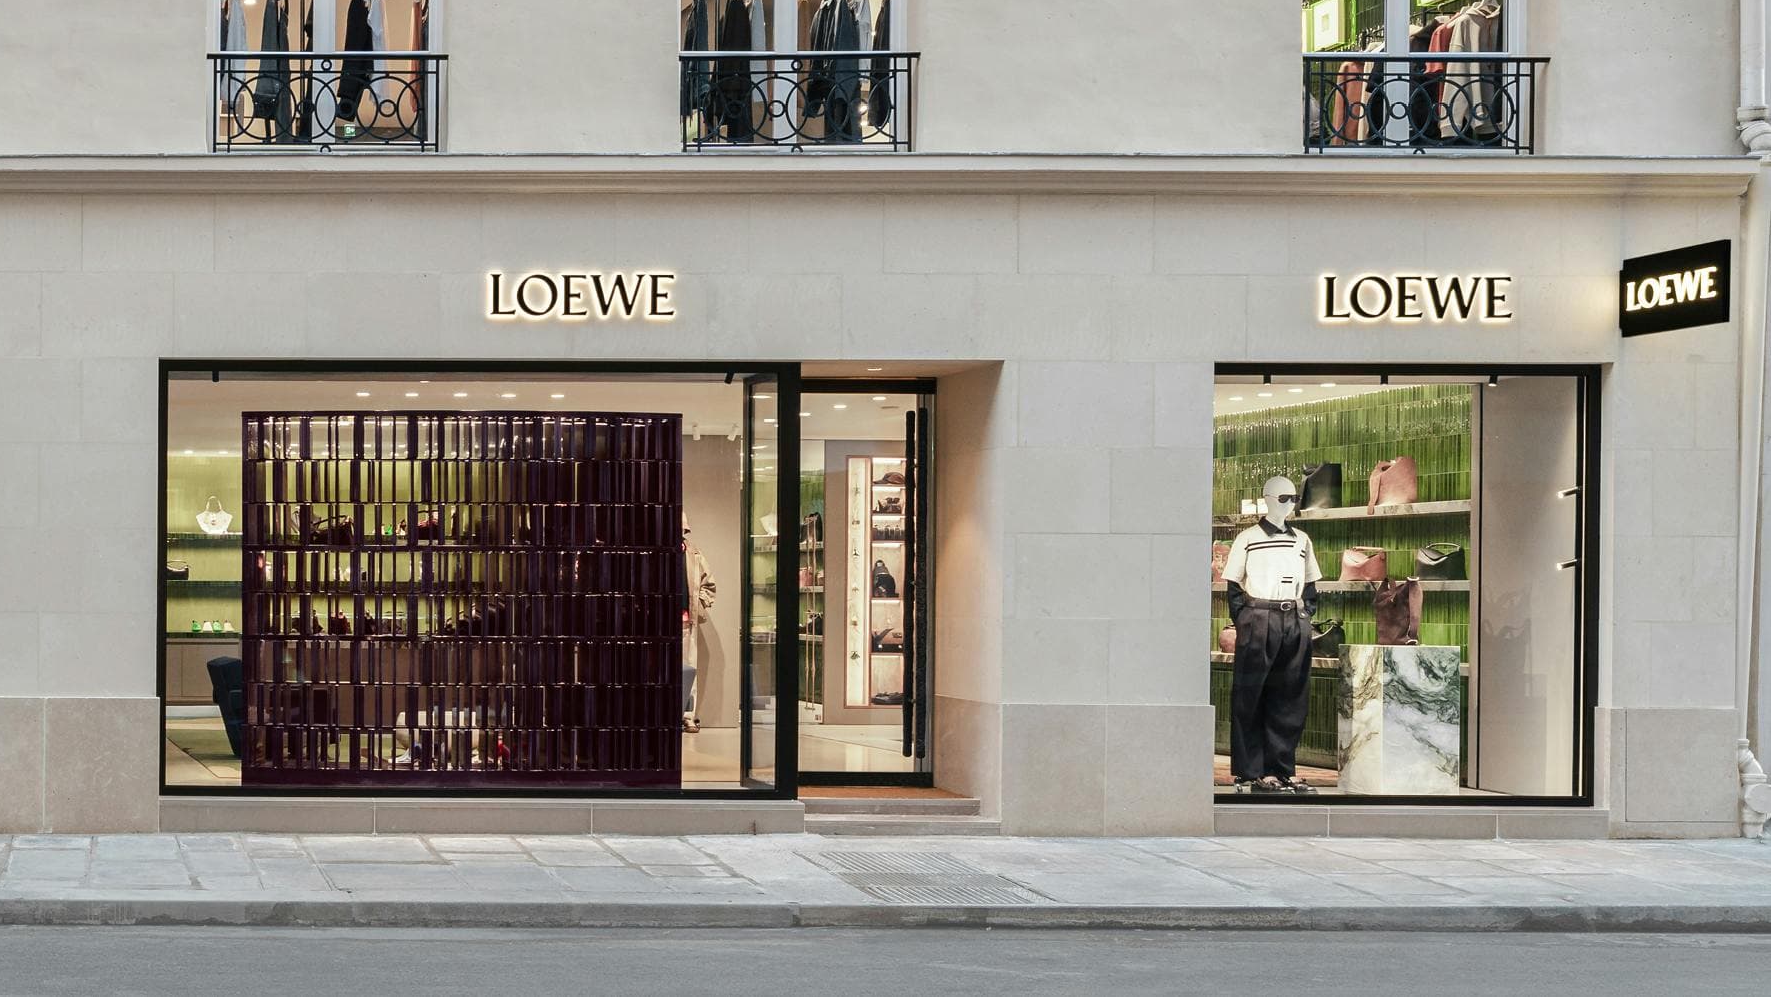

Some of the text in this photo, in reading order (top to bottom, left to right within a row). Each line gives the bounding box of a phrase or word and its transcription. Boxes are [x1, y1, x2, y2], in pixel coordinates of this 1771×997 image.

[490, 274, 675, 317] LOEWE
[1324, 276, 1513, 319] LOEWE
[1626, 266, 1717, 312] LOEWE
